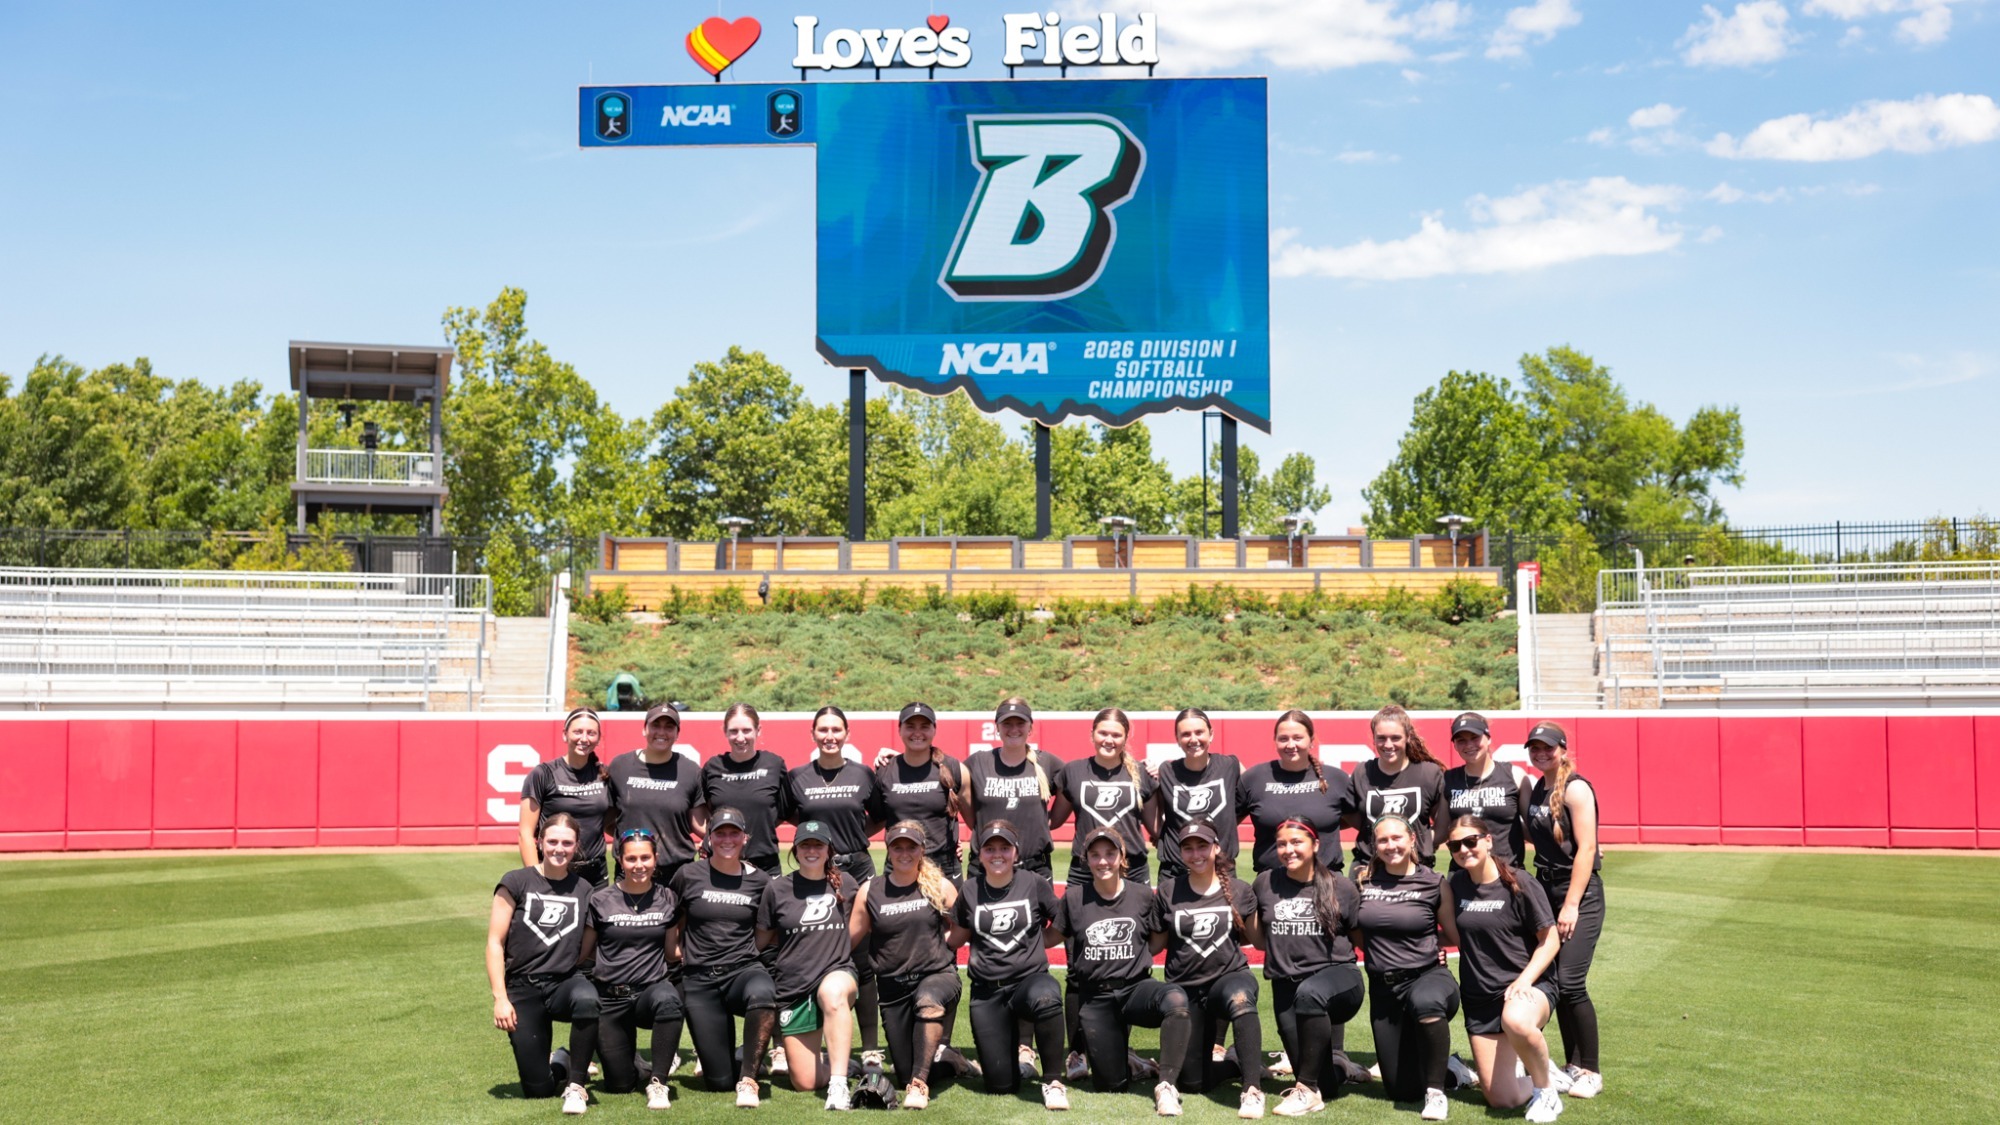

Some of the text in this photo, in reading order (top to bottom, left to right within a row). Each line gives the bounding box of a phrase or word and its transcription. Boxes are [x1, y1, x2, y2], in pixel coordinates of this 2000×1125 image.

[1003, 12, 1160, 66] Field
[661, 104, 732, 127] NCAA
[937, 113, 1147, 302] B
[1083, 339, 1237, 359] 2026 DIVISION I
[1114, 360, 1205, 378] SOFTBALL
[1088, 379, 1233, 399] CHAMPIONSHIP
[804, 784, 860, 796] BINGHAMTON
[984, 786, 1039, 797] STARTS HERE
[985, 776, 1039, 789] TRADITION
[1094, 786, 1123, 810] B
[1186, 788, 1213, 813] B
[1450, 786, 1506, 800] TRADITION
[1450, 796, 1507, 809] STARTS HERE
[537, 900, 568, 928] B
[800, 893, 838, 926] B
[785, 922, 845, 935] SOFTBALL
[990, 908, 1018, 935] B
[1192, 912, 1220, 940] B
[1271, 921, 1325, 936] SOFTBALL
[1085, 945, 1136, 961] SOFTBALL
